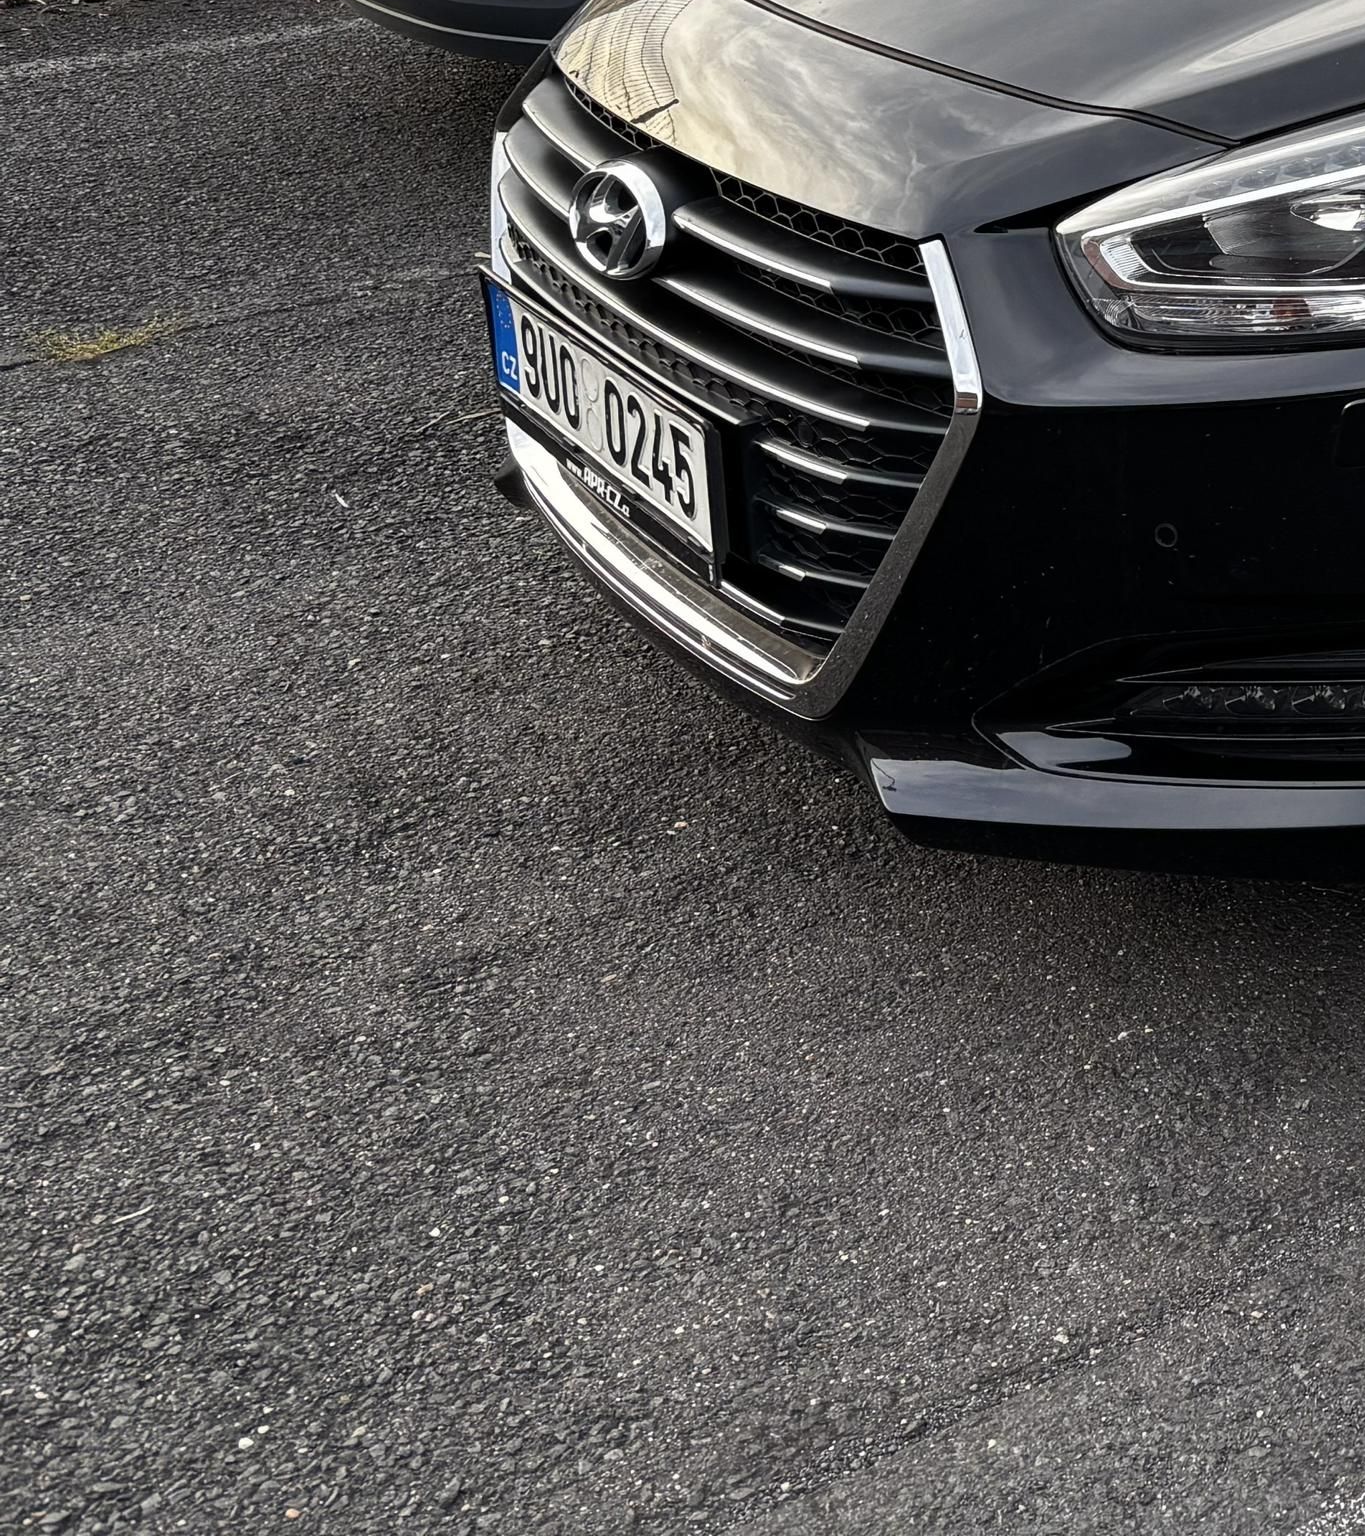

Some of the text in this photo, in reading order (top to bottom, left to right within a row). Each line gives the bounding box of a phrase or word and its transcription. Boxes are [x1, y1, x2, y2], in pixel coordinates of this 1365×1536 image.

[501, 314, 697, 520] CZ 9U0 0245
